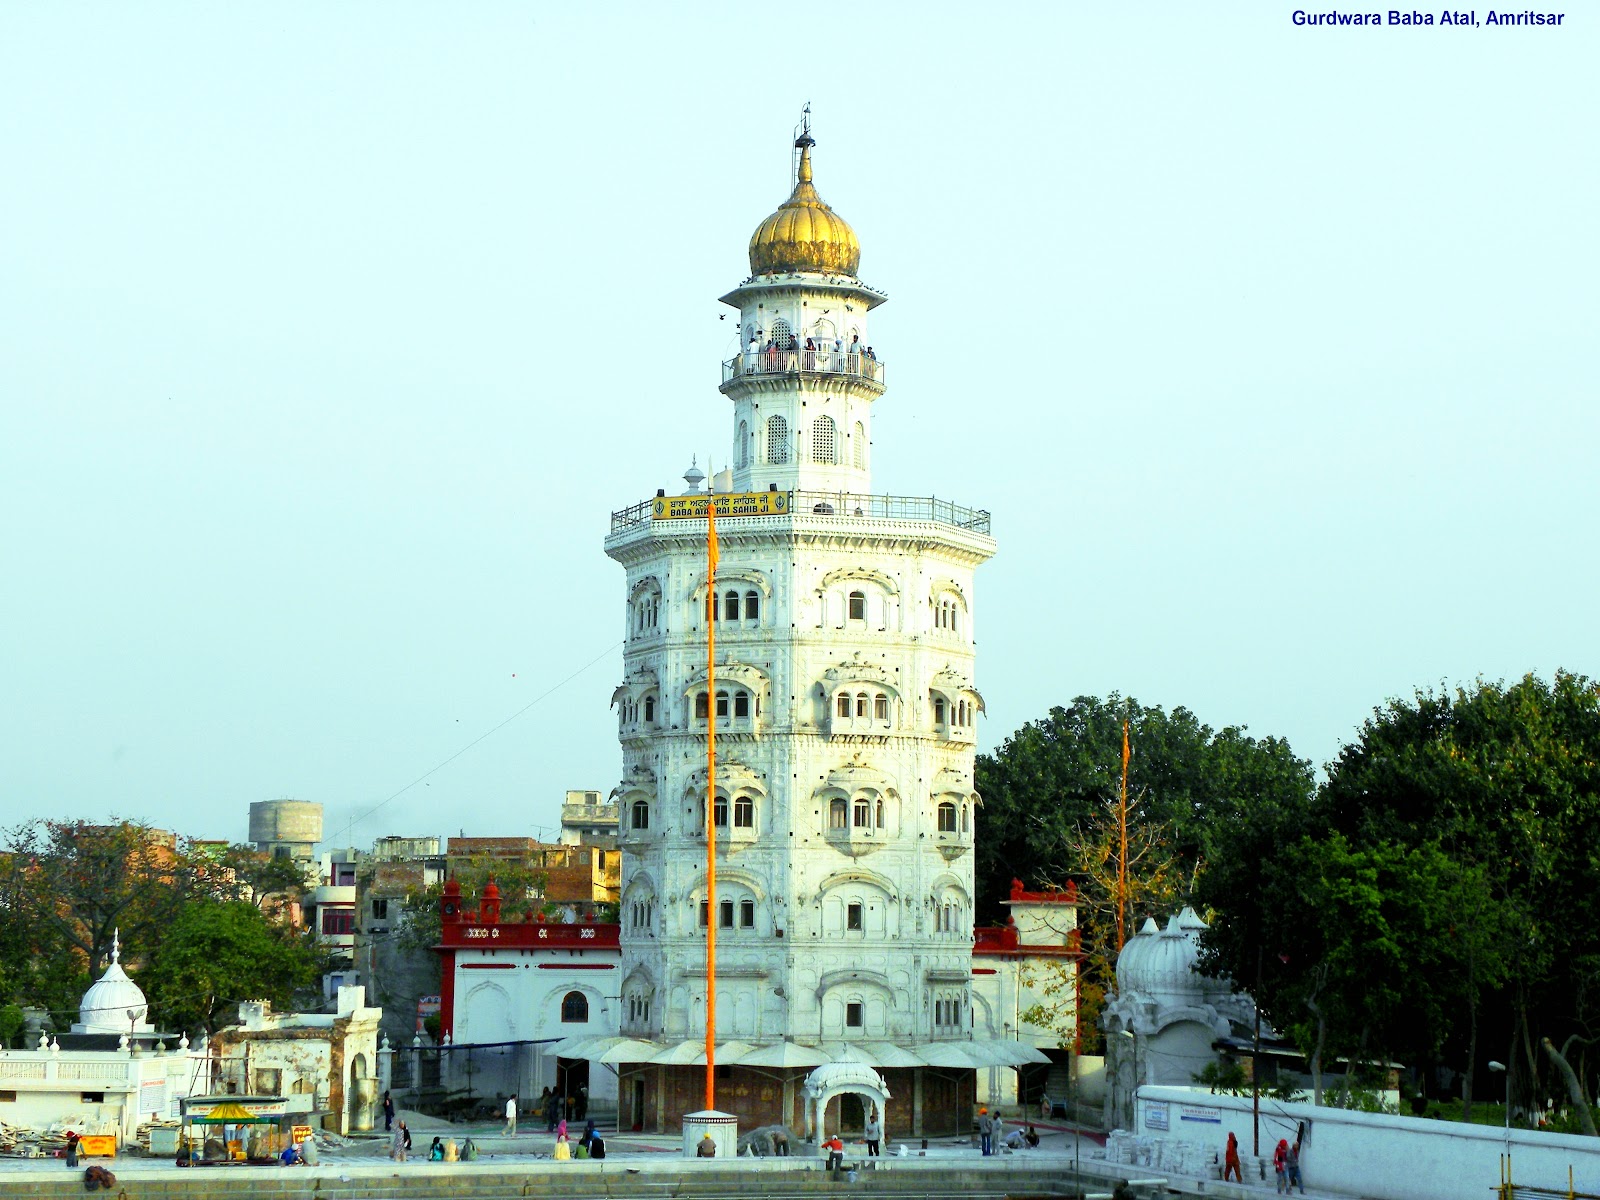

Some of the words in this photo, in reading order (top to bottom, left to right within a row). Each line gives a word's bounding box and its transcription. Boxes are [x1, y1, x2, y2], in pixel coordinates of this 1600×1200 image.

[670, 500, 687, 508] ਬਾਬਾ
[759, 494, 769, 504] ਜੀ
[670, 508, 692, 517] BABA
[694, 507, 712, 516] ATA
[716, 506, 730, 515] RAI
[760, 504, 769, 513] JI
